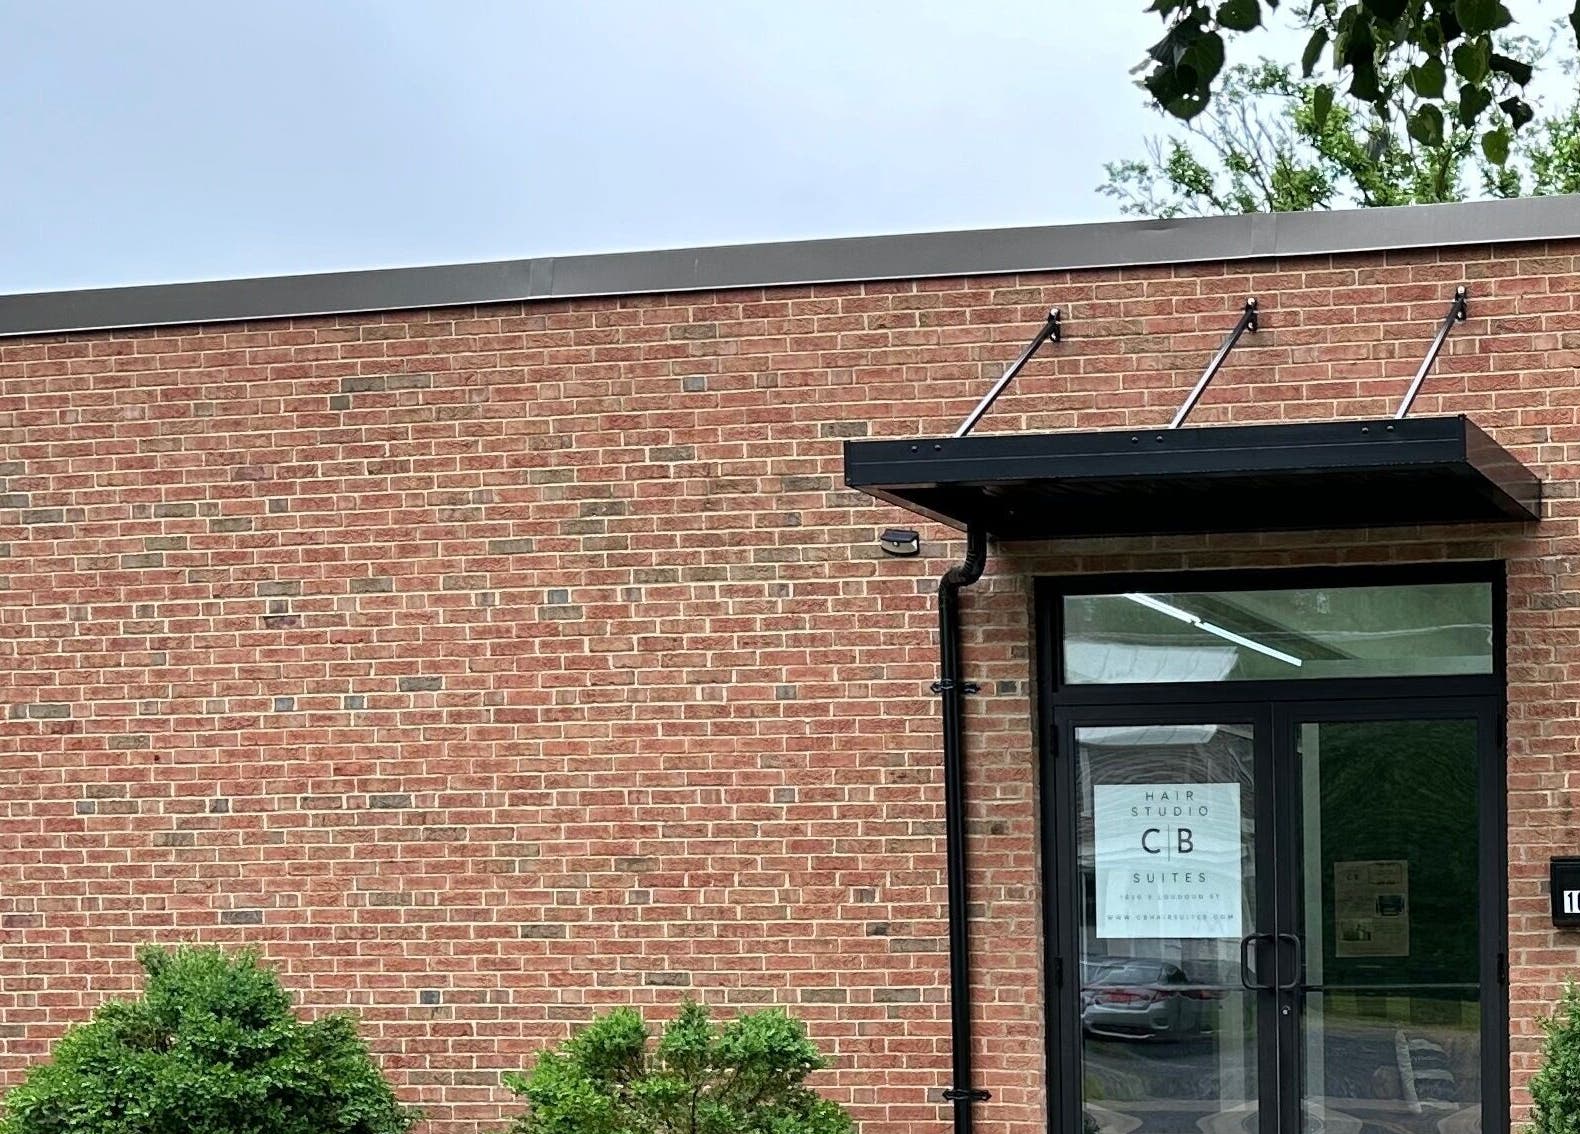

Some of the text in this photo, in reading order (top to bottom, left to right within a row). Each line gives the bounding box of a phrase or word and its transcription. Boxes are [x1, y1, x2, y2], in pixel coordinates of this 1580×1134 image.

[1145, 791, 1194, 801] HAIR
[1131, 806, 1208, 816] STUDIO
[1133, 872, 1206, 883] SUITES
